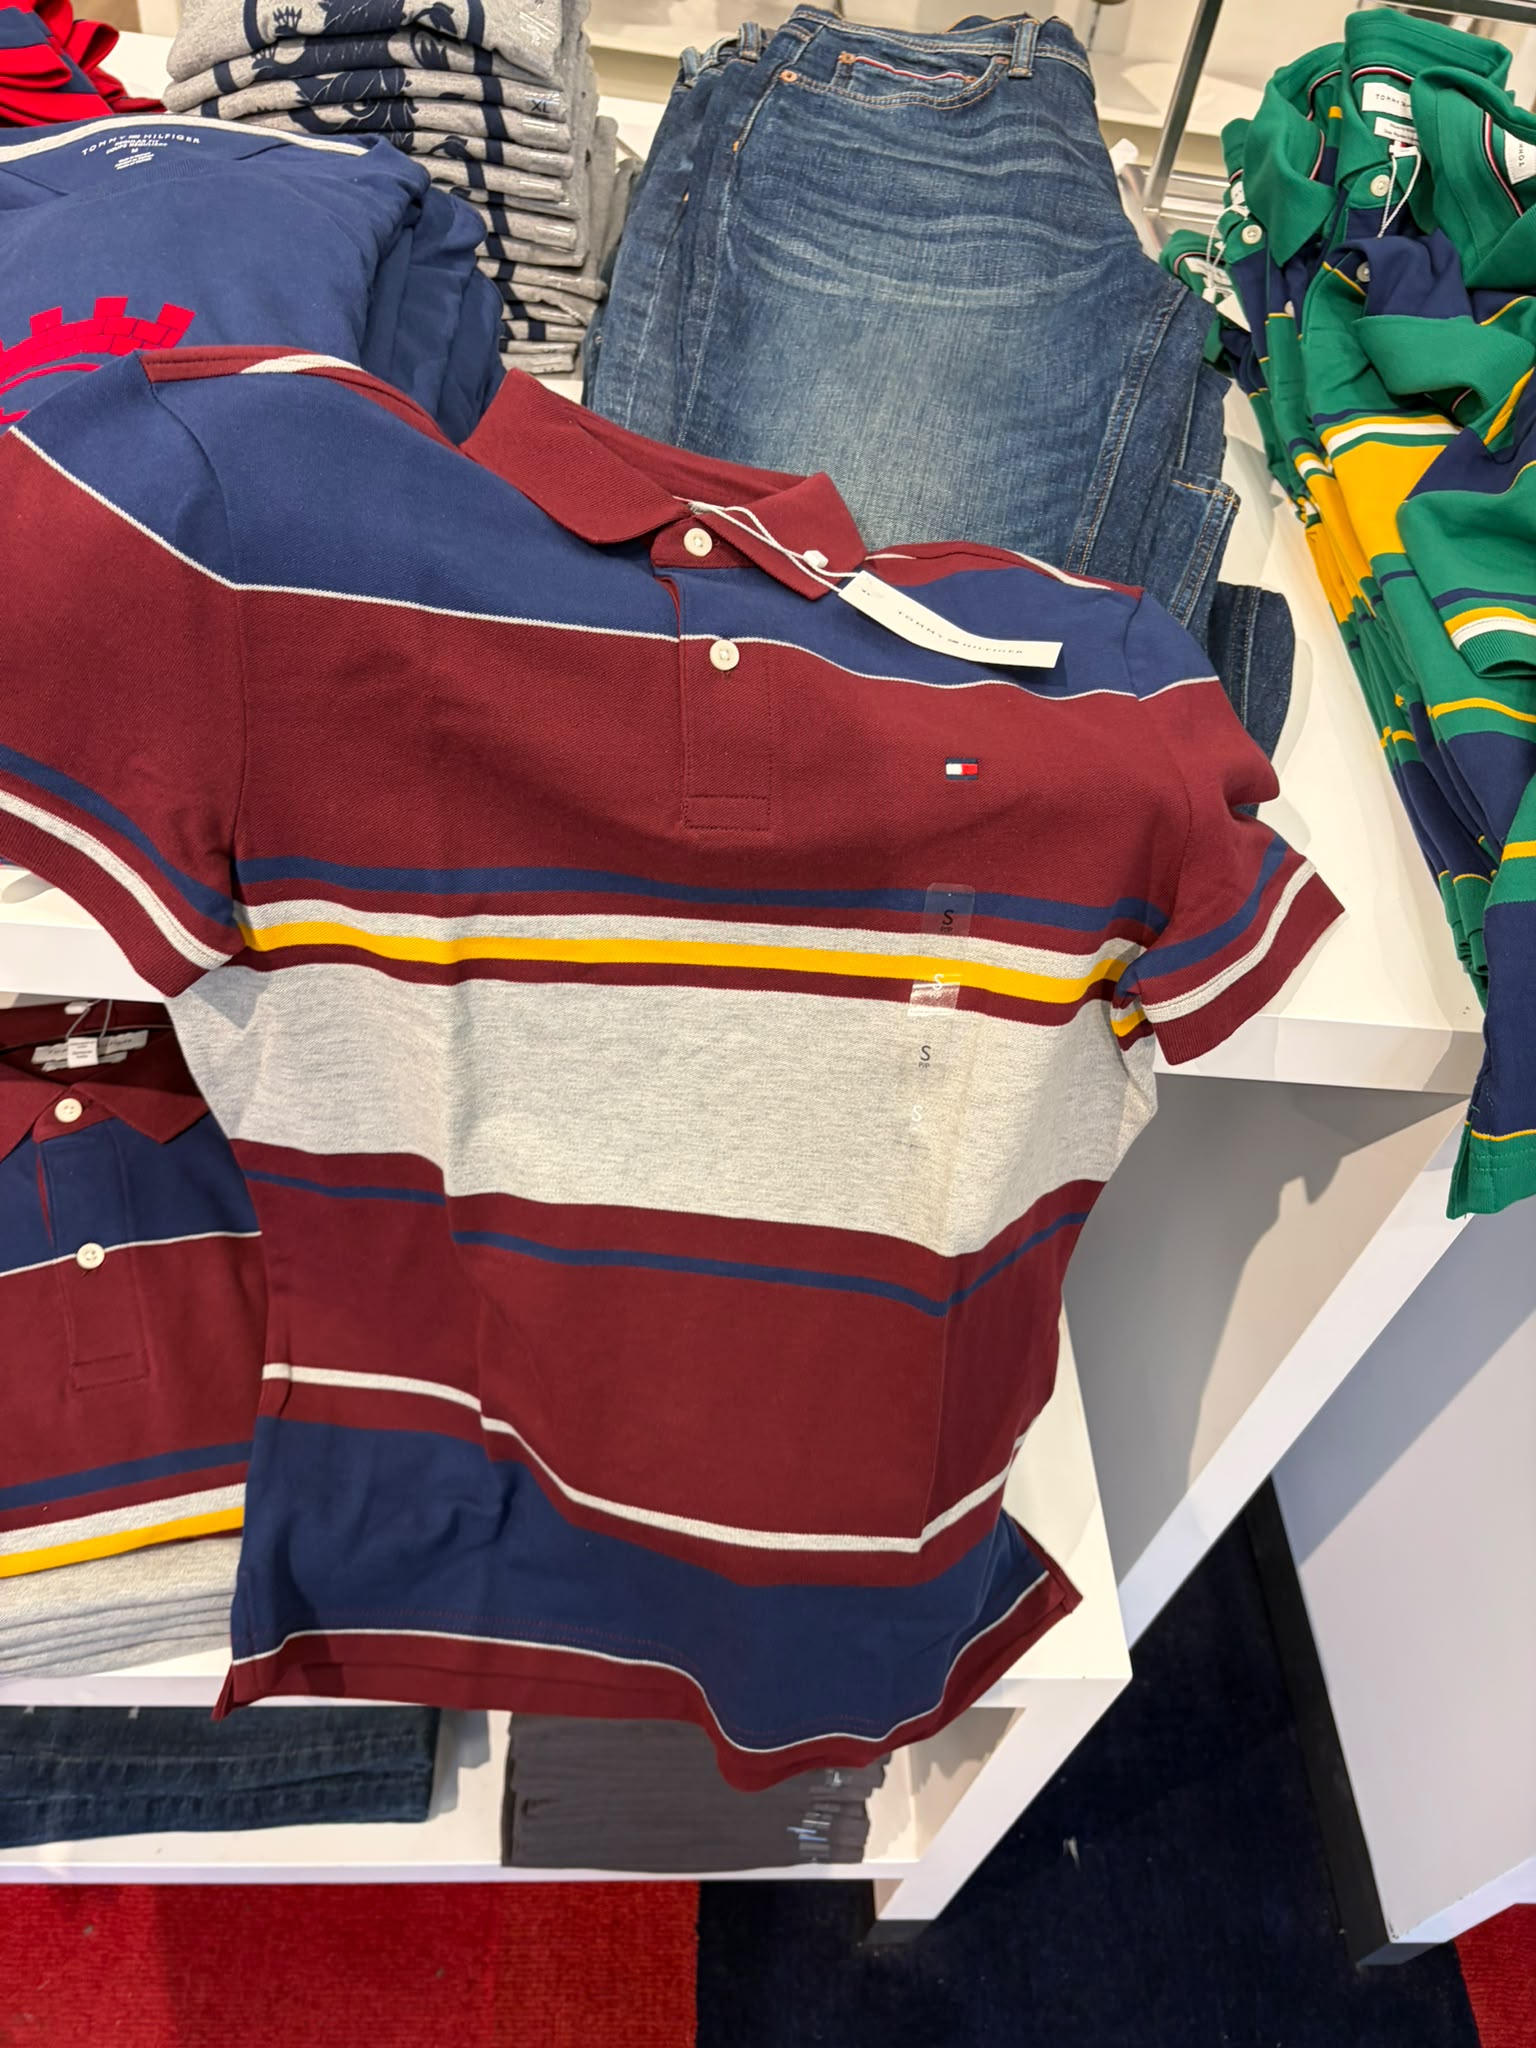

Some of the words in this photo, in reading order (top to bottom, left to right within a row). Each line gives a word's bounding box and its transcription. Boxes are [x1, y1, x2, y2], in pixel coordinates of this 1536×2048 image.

[531, 100, 549, 113] XL
[81, 135, 126, 156] TOMMY
[143, 133, 201, 145] HILFIGER
[1518, 143, 1526, 167] TOMM
[942, 909, 955, 926] S
[932, 973, 945, 990] S
[920, 1044, 932, 1061] S
[911, 1104, 924, 1122] S
